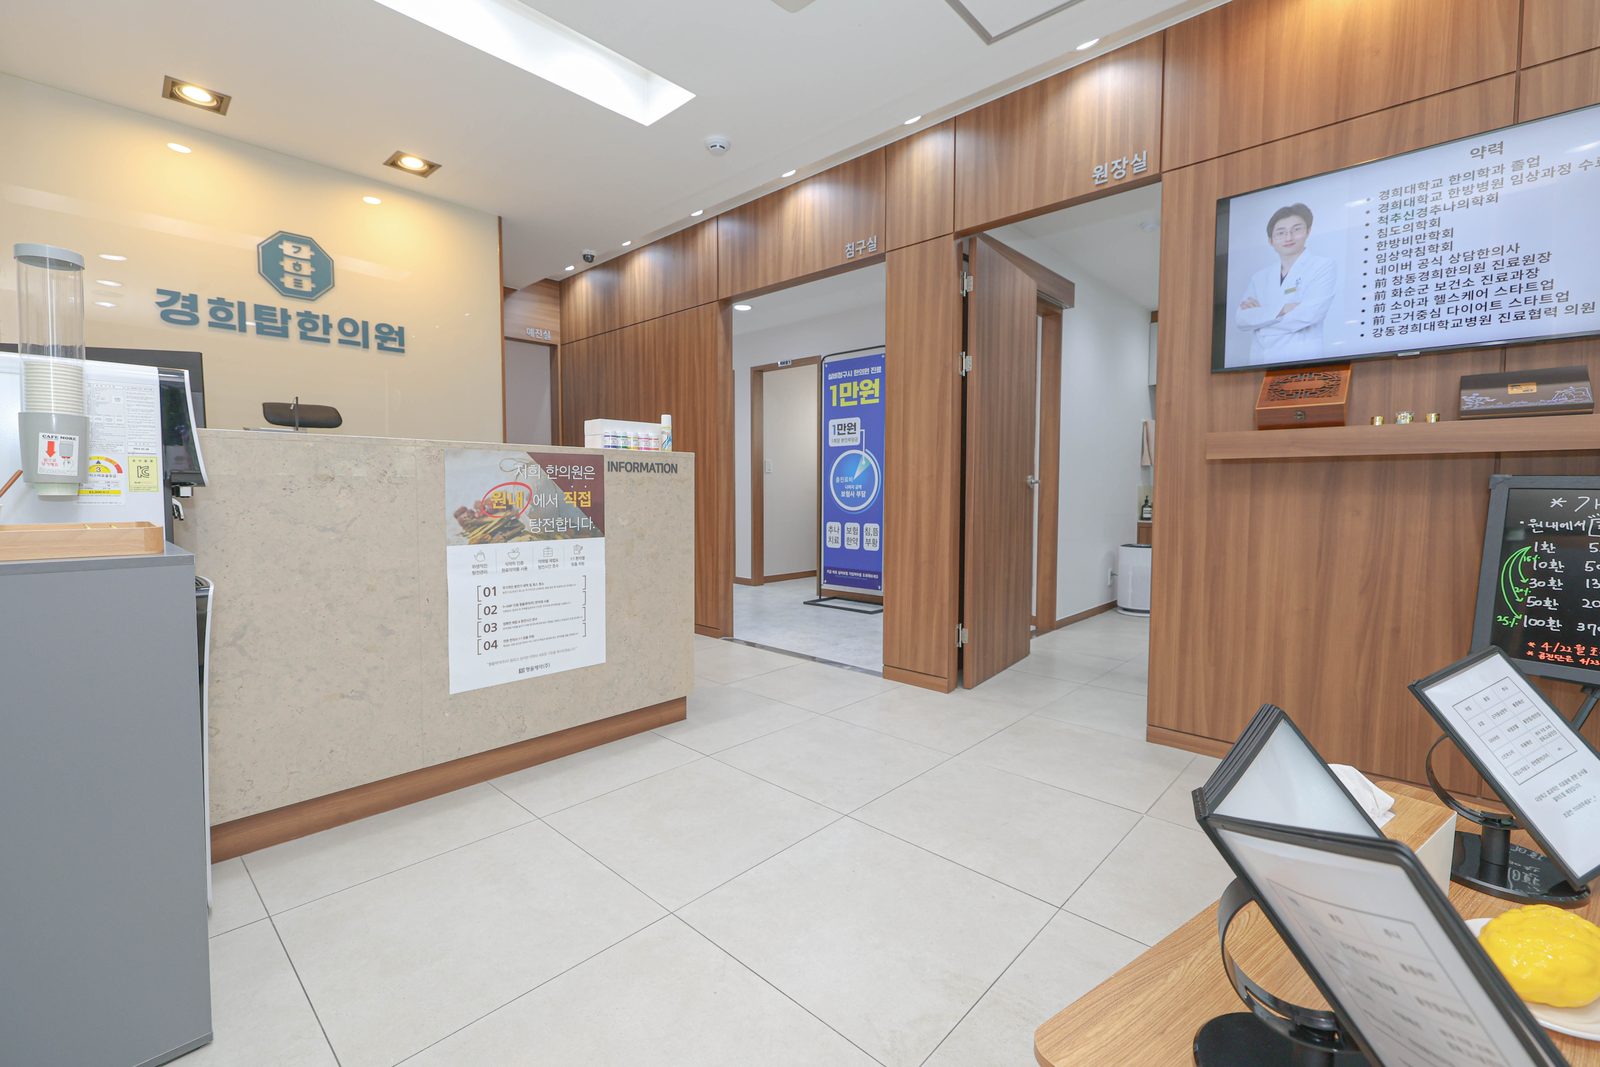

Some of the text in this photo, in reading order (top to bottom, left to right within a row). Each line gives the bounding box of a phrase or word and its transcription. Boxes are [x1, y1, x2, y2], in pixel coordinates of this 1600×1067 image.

[1470, 141, 1504, 159] 약력
[1092, 150, 1148, 185] 원장실
[1379, 155, 1541, 200] 경희대학교 한의학과 졸업
[1378, 191, 1442, 213] 경희대학교
[1448, 177, 1504, 199] 한방병원
[1510, 163, 1572, 186] 임상과정
[1377, 192, 1499, 225] 척추신경추나의학회
[1377, 217, 1441, 238] 침도의학회
[844, 235, 878, 259] 침구실
[1376, 227, 1454, 251] 한방비만학회
[1375, 241, 1453, 264] 임상약침학회
[1375, 242, 1521, 275] 네이버 공식 상담한의사
[1392, 261, 1486, 286] 창동경희한의원
[1492, 251, 1552, 271] 진료원장
[1391, 284, 1429, 298] 화순군
[1434, 277, 1475, 291] 보건소
[1481, 267, 1540, 286] 진료과장
[1390, 296, 1428, 311] 소아과
[1434, 288, 1488, 305] 헬스케어
[1494, 278, 1555, 297] 스타트업
[1390, 307, 1441, 324] 근거중심
[1447, 299, 1503, 315] 다이어트
[1508, 290, 1570, 308] 스타트업
[155, 288, 406, 354] 경희탑한의원
[1372, 301, 1596, 338] 강동경희대학교병원 진료협력 의원
[830, 378, 880, 407] 1만원
[832, 422, 857, 436] 1만원
[514, 464, 596, 480] 저희 한의원은
[607, 461, 678, 474] INFORMATION
[490, 490, 592, 509] 원내 에서 직접
[529, 516, 596, 534] 탕전합니다.
[828, 526, 840, 534] 추나
[846, 526, 858, 535] 보험
[1527, 518, 1586, 533] 원내에서
[828, 536, 840, 544] 치료
[847, 537, 859, 546] 한약
[1534, 541, 1556, 553] 1환
[1533, 559, 1565, 573] 10환
[483, 586, 497, 597] 01
[1529, 577, 1564, 590] 30환
[483, 605, 498, 616] 02
[1526, 596, 1559, 610] 50환
[483, 622, 498, 633] 03
[1523, 615, 1562, 631] 100환
[483, 640, 498, 651] 04
[1538, 651, 1574, 663] 공진단은
